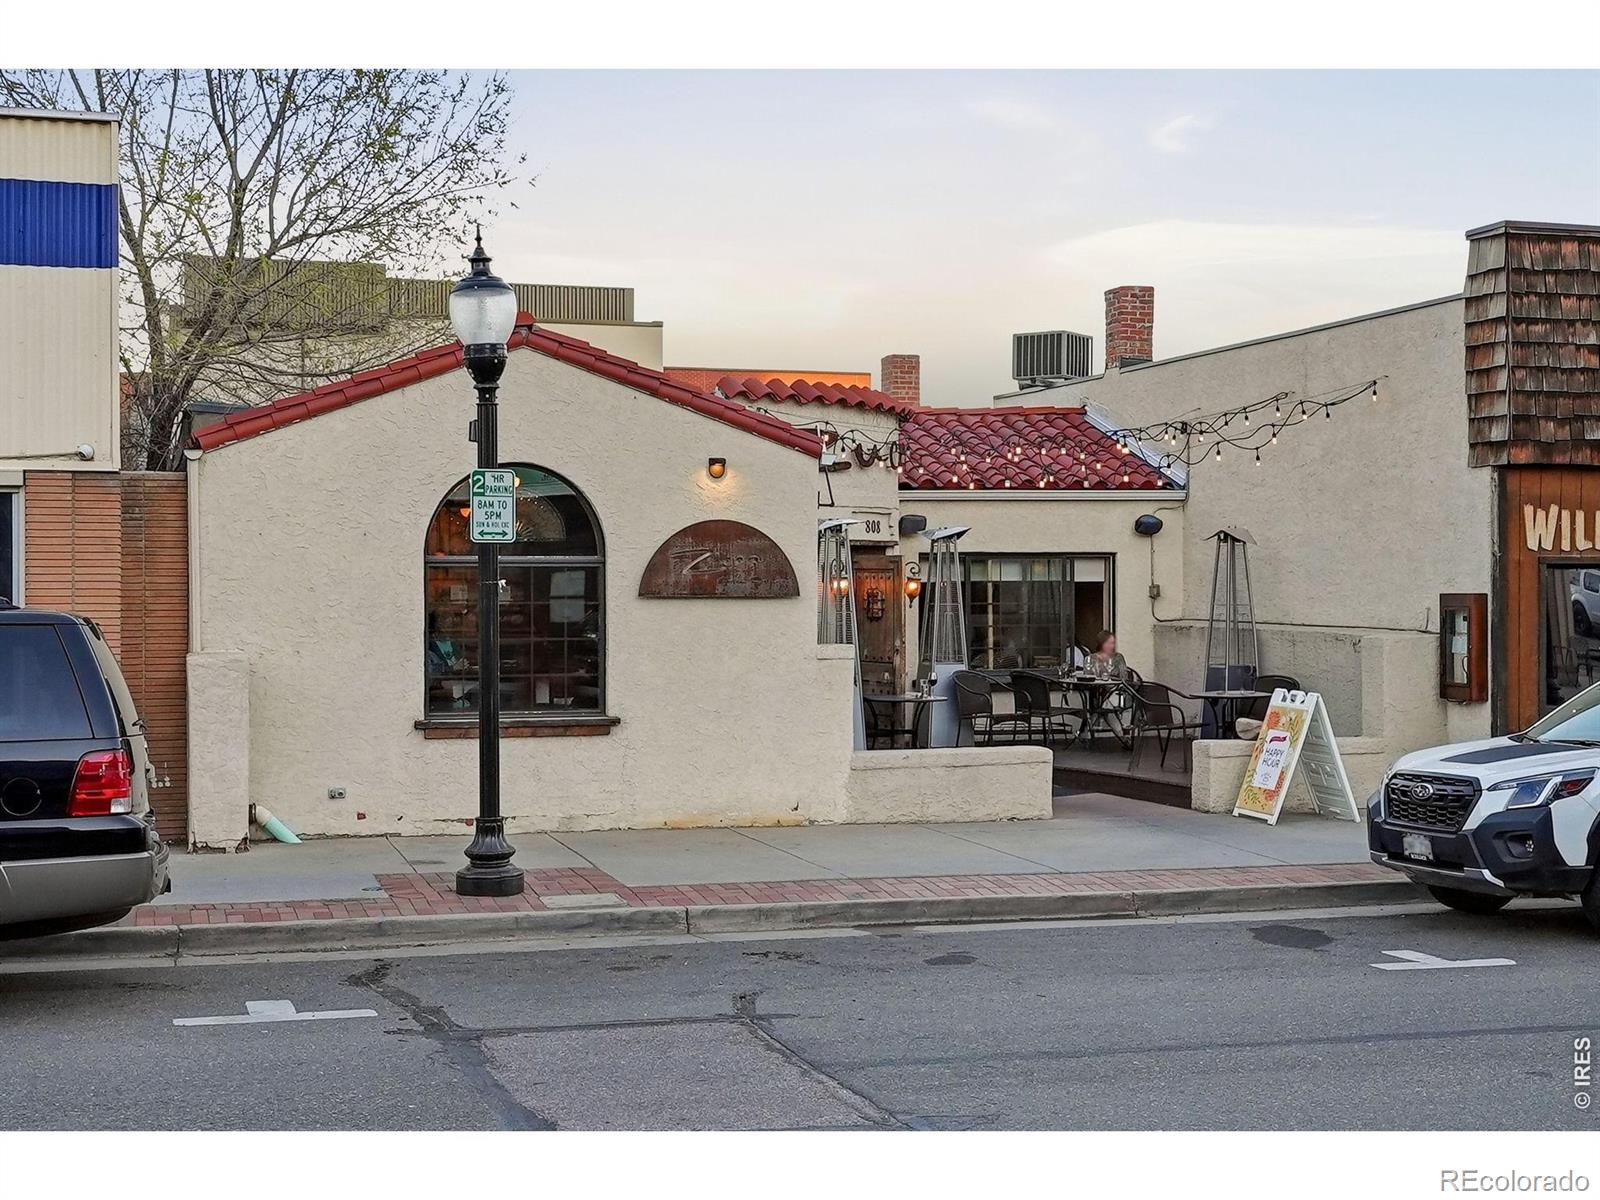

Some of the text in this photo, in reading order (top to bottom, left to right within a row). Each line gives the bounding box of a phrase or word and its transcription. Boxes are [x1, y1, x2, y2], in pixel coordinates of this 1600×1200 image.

[473, 474, 505, 493] 2 HR
[485, 485, 513, 494] PARKING
[477, 500, 507, 510] 8AM TO
[484, 511, 502, 520] 5PM
[865, 520, 881, 533] 808
[1523, 502, 1600, 552] WIL
[1264, 747, 1285, 758] HAPPY
[1262, 757, 1281, 768] HOUR
